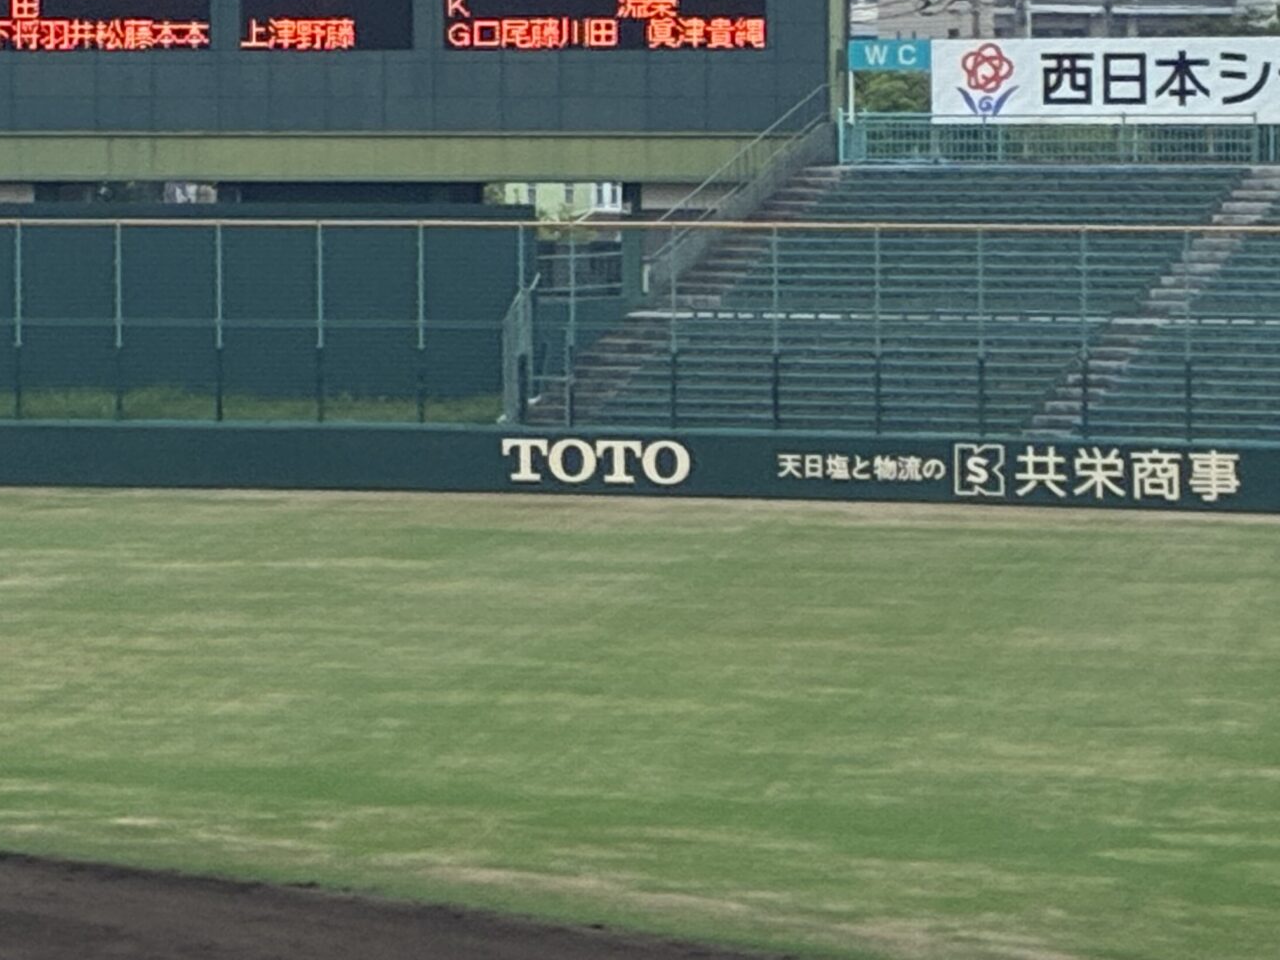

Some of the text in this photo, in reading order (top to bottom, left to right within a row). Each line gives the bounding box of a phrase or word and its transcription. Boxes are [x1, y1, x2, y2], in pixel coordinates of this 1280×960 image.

[865, 44, 917, 66] WC
[1040, 50, 1280, 107] 西日本シ
[501, 438, 691, 485] TOTO
[777, 453, 946, 483] 天日塩と物流の
[1015, 445, 1242, 503] 共栄商事
